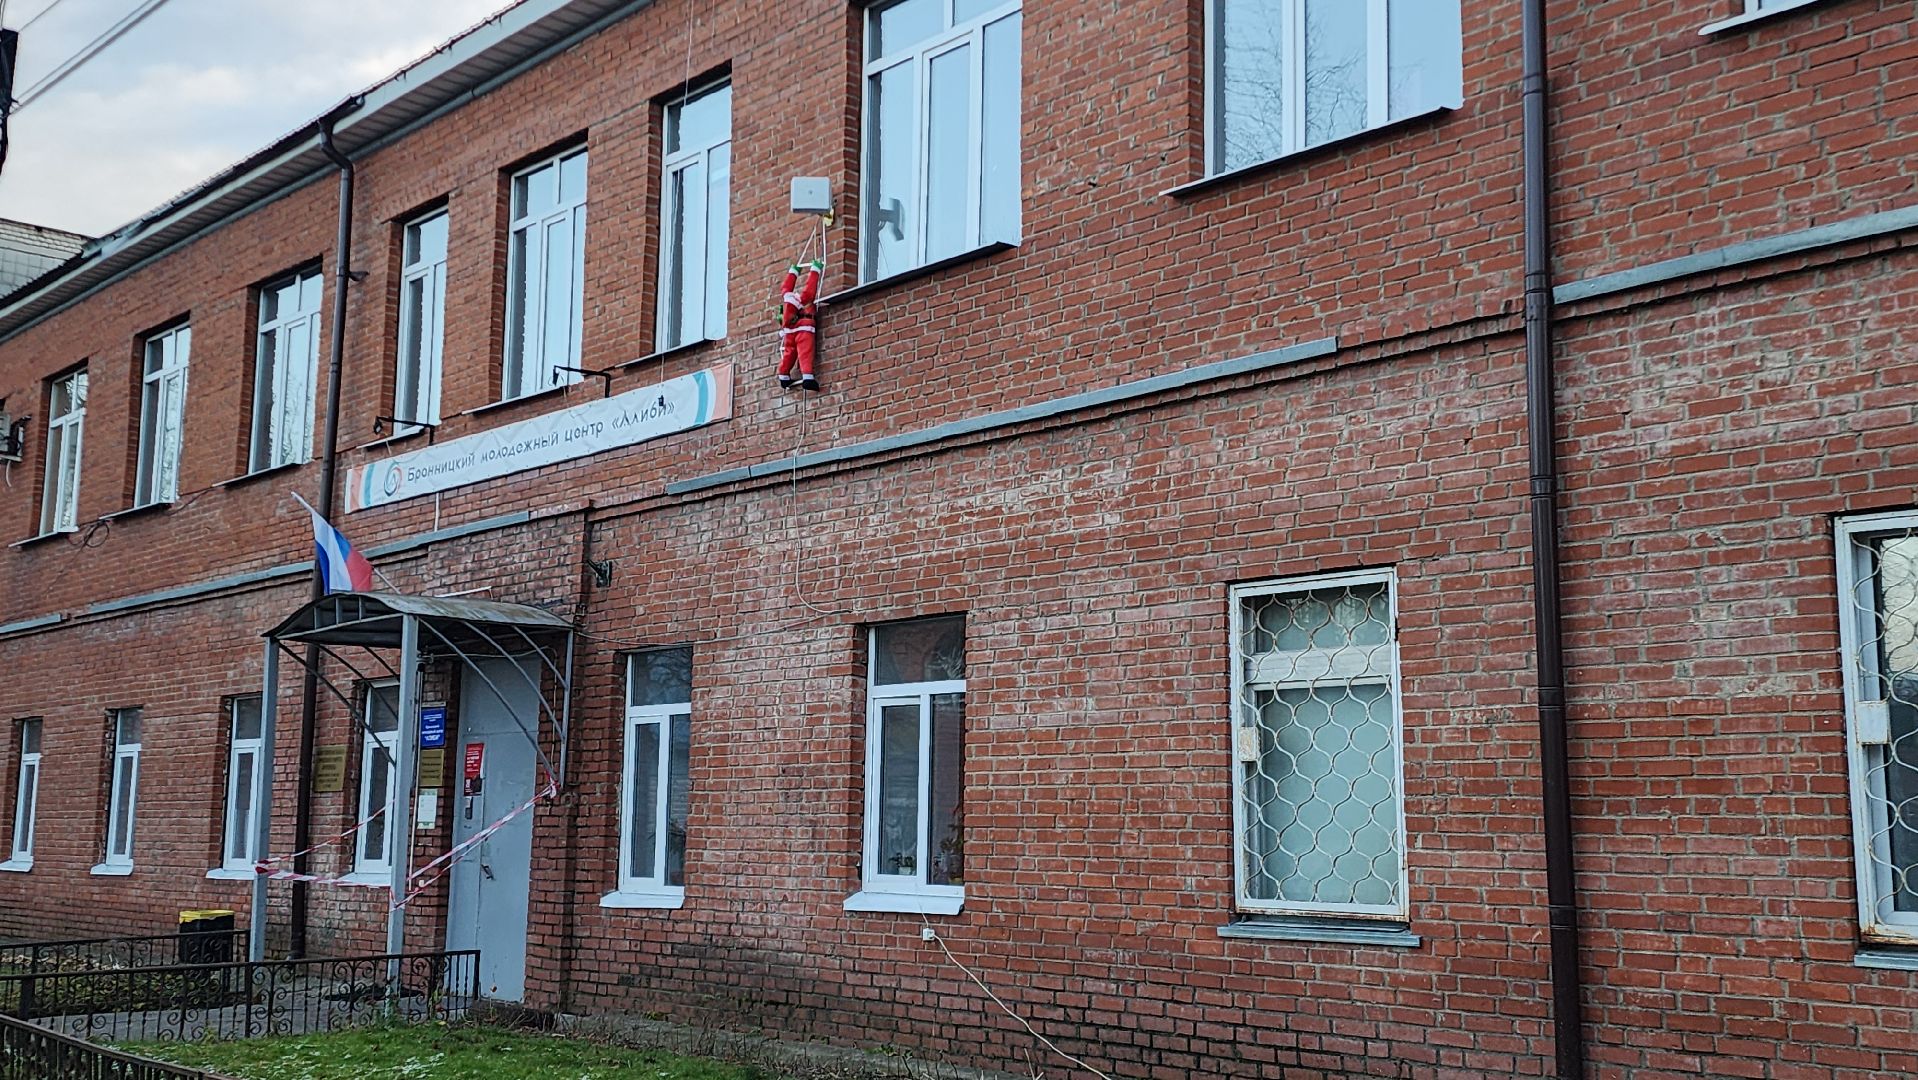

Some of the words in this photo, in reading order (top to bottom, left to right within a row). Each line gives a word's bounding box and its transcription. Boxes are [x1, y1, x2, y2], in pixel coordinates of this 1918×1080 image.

[407, 453, 475, 482] Бронницкий
[480, 431, 559, 464] молодежный
[564, 421, 604, 443] центр
